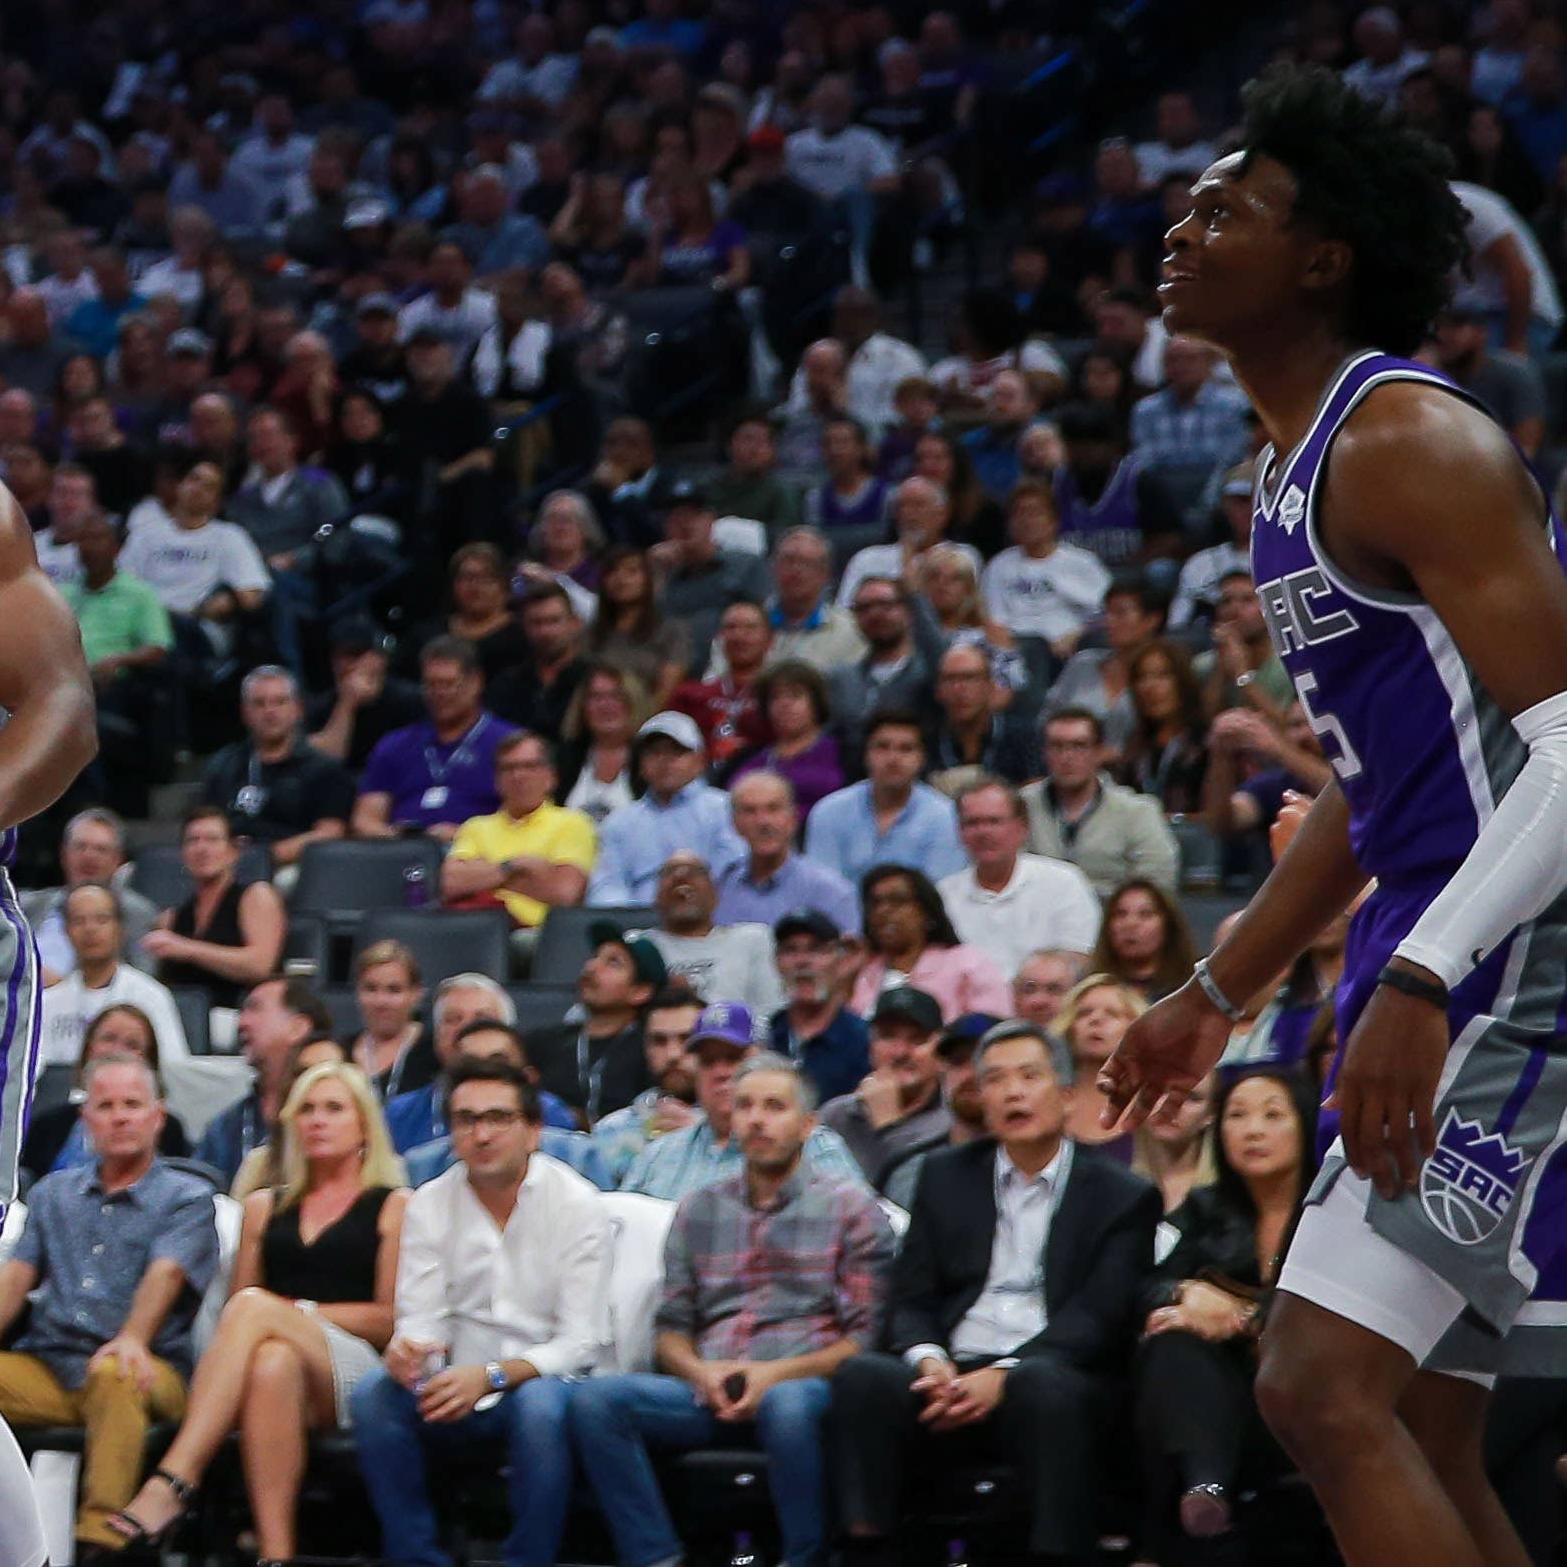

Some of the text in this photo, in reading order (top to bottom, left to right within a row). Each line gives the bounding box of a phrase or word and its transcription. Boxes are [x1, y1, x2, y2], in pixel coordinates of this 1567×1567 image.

[1256, 565, 1361, 657] AC
[1293, 671, 1363, 780] 5
[1429, 1147, 1515, 1218] SAC
